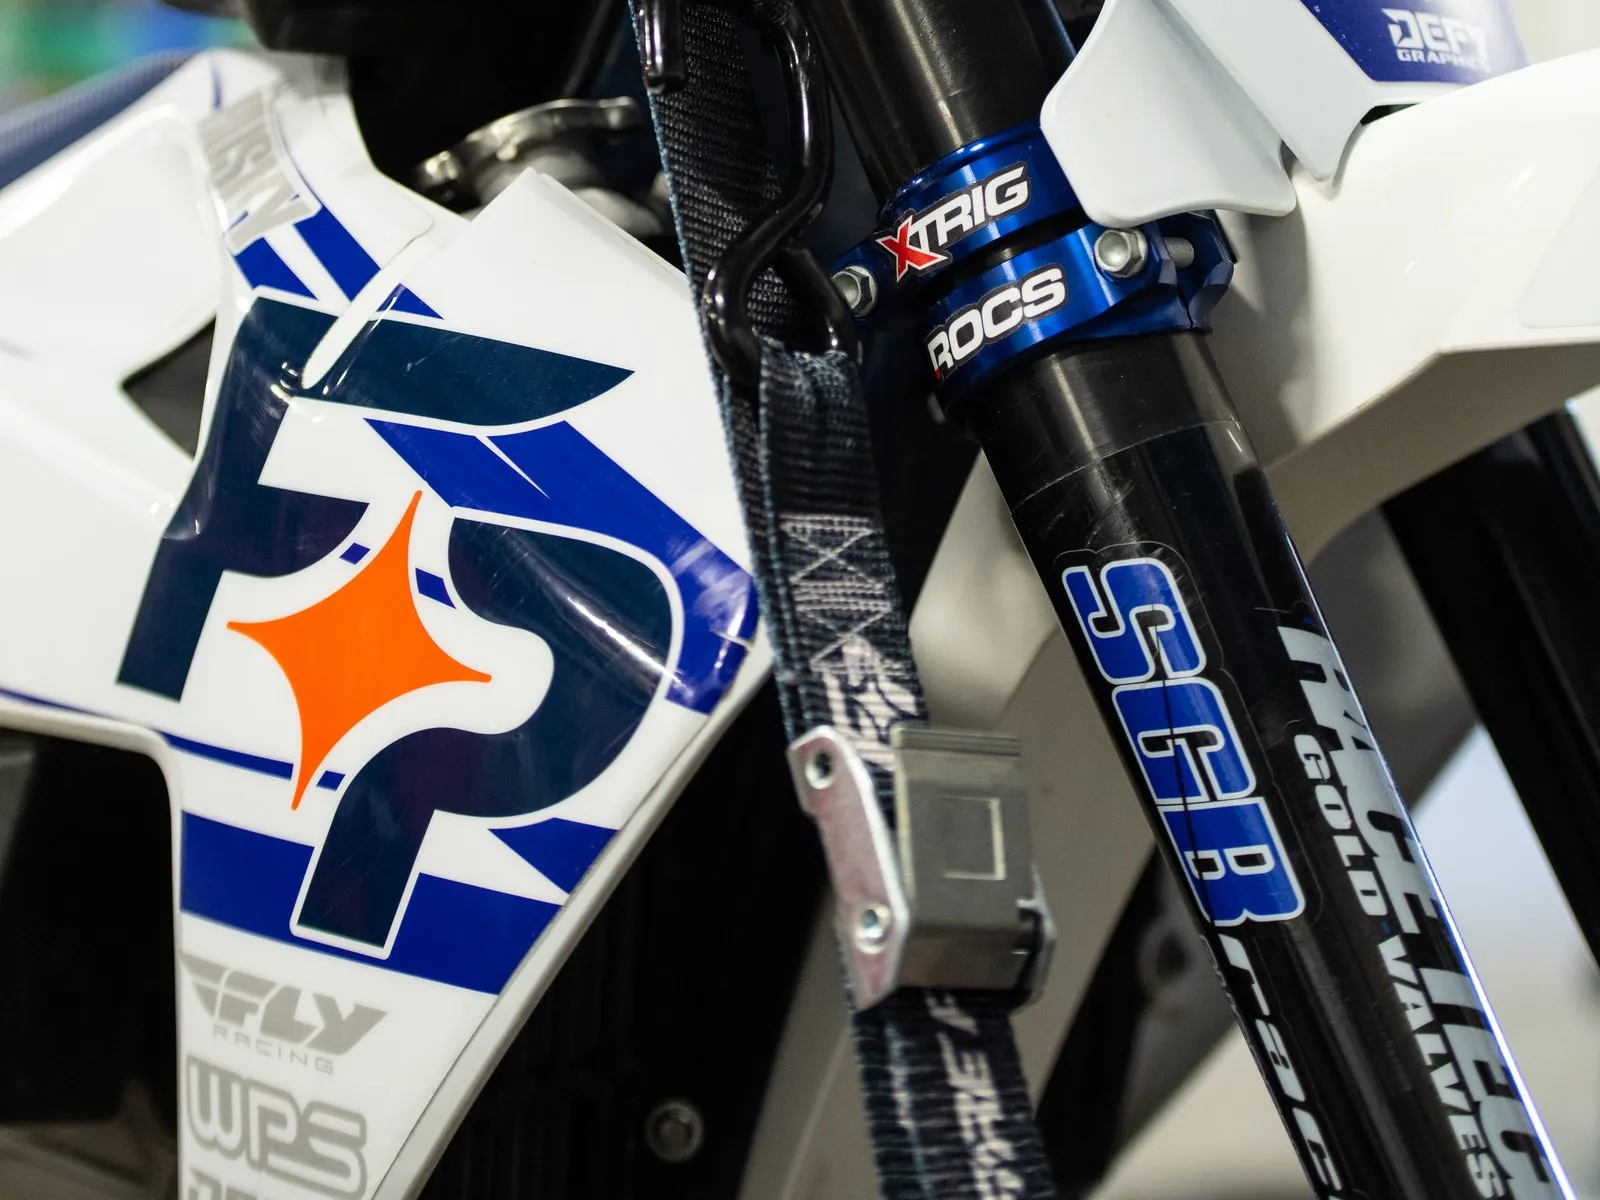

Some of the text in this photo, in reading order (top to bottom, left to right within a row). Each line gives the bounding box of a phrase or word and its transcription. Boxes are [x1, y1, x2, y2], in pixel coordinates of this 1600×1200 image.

[875, 166, 1029, 284] XTRIG
[927, 267, 1066, 380] ROCS
[179, 951, 388, 1056] FLY
[1294, 734, 1506, 1199] GOLD VALVES
[212, 1024, 335, 1076] RACING
[1218, 933, 1344, 1200] rac
[186, 1054, 368, 1199] WPS
